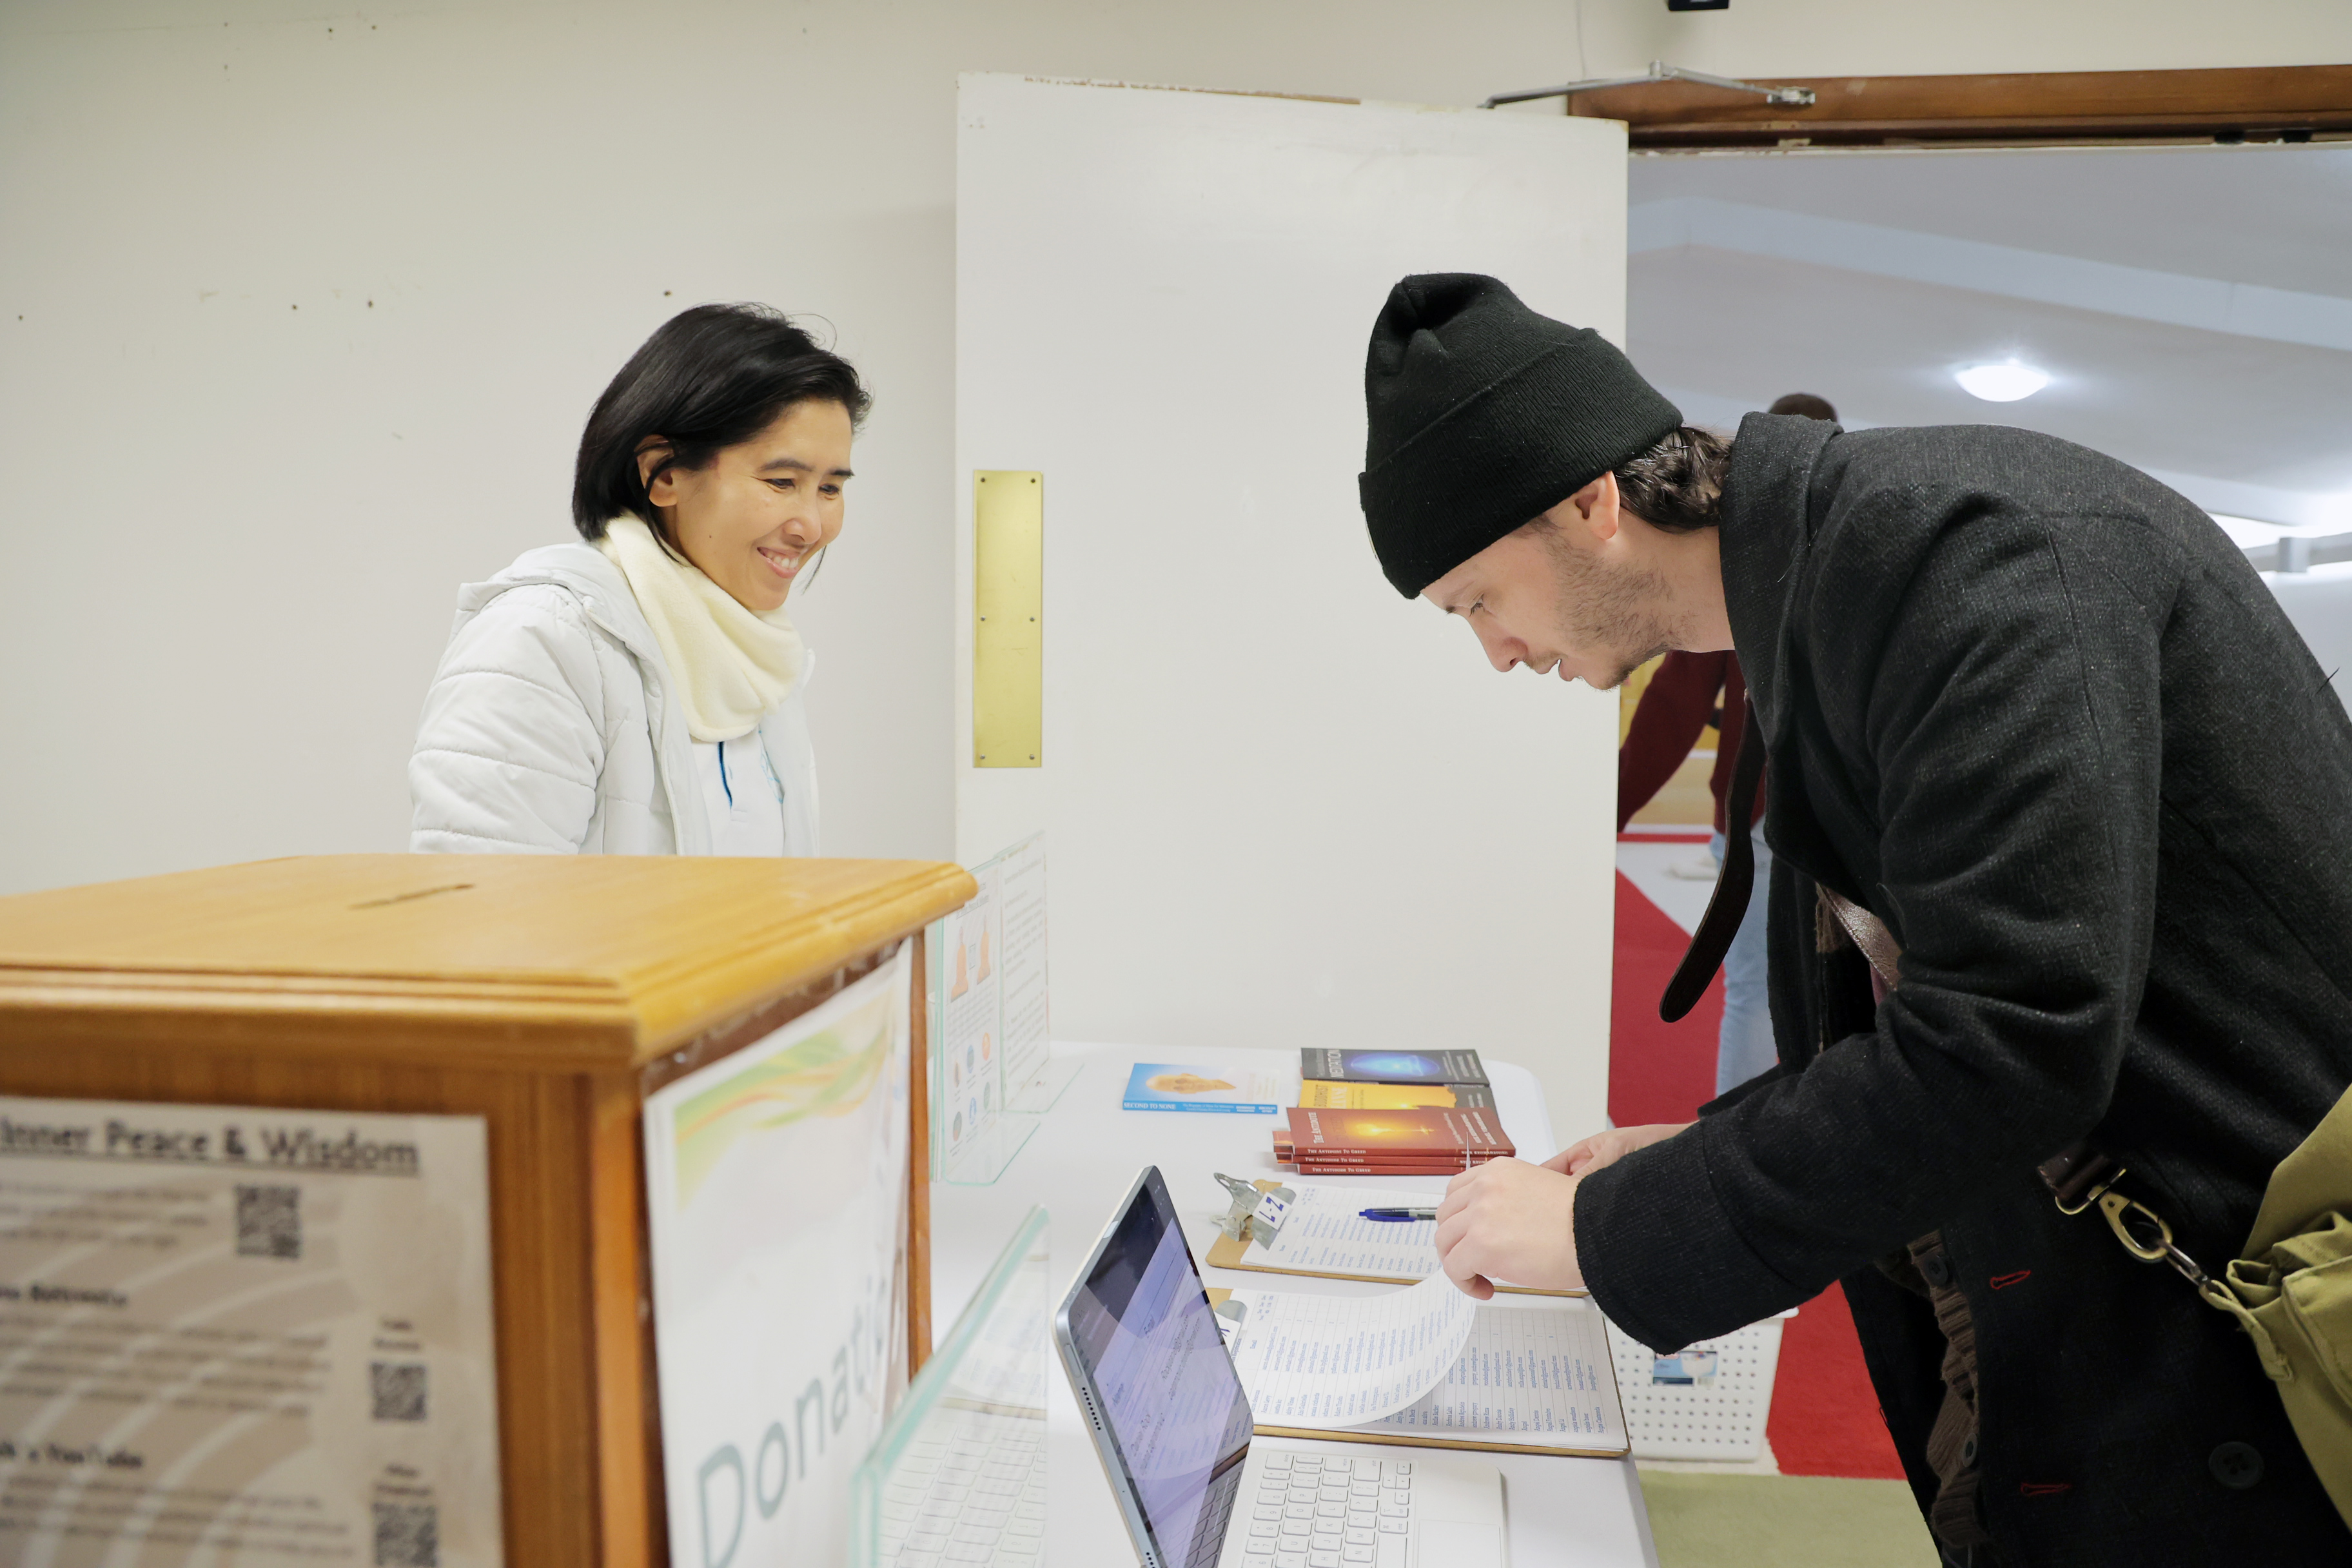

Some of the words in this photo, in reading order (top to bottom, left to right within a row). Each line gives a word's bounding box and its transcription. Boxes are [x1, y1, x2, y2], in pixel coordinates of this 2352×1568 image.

[106, 1121, 209, 1155] Peace
[225, 1128, 246, 1156] &
[260, 1128, 418, 1166] Wisdom
